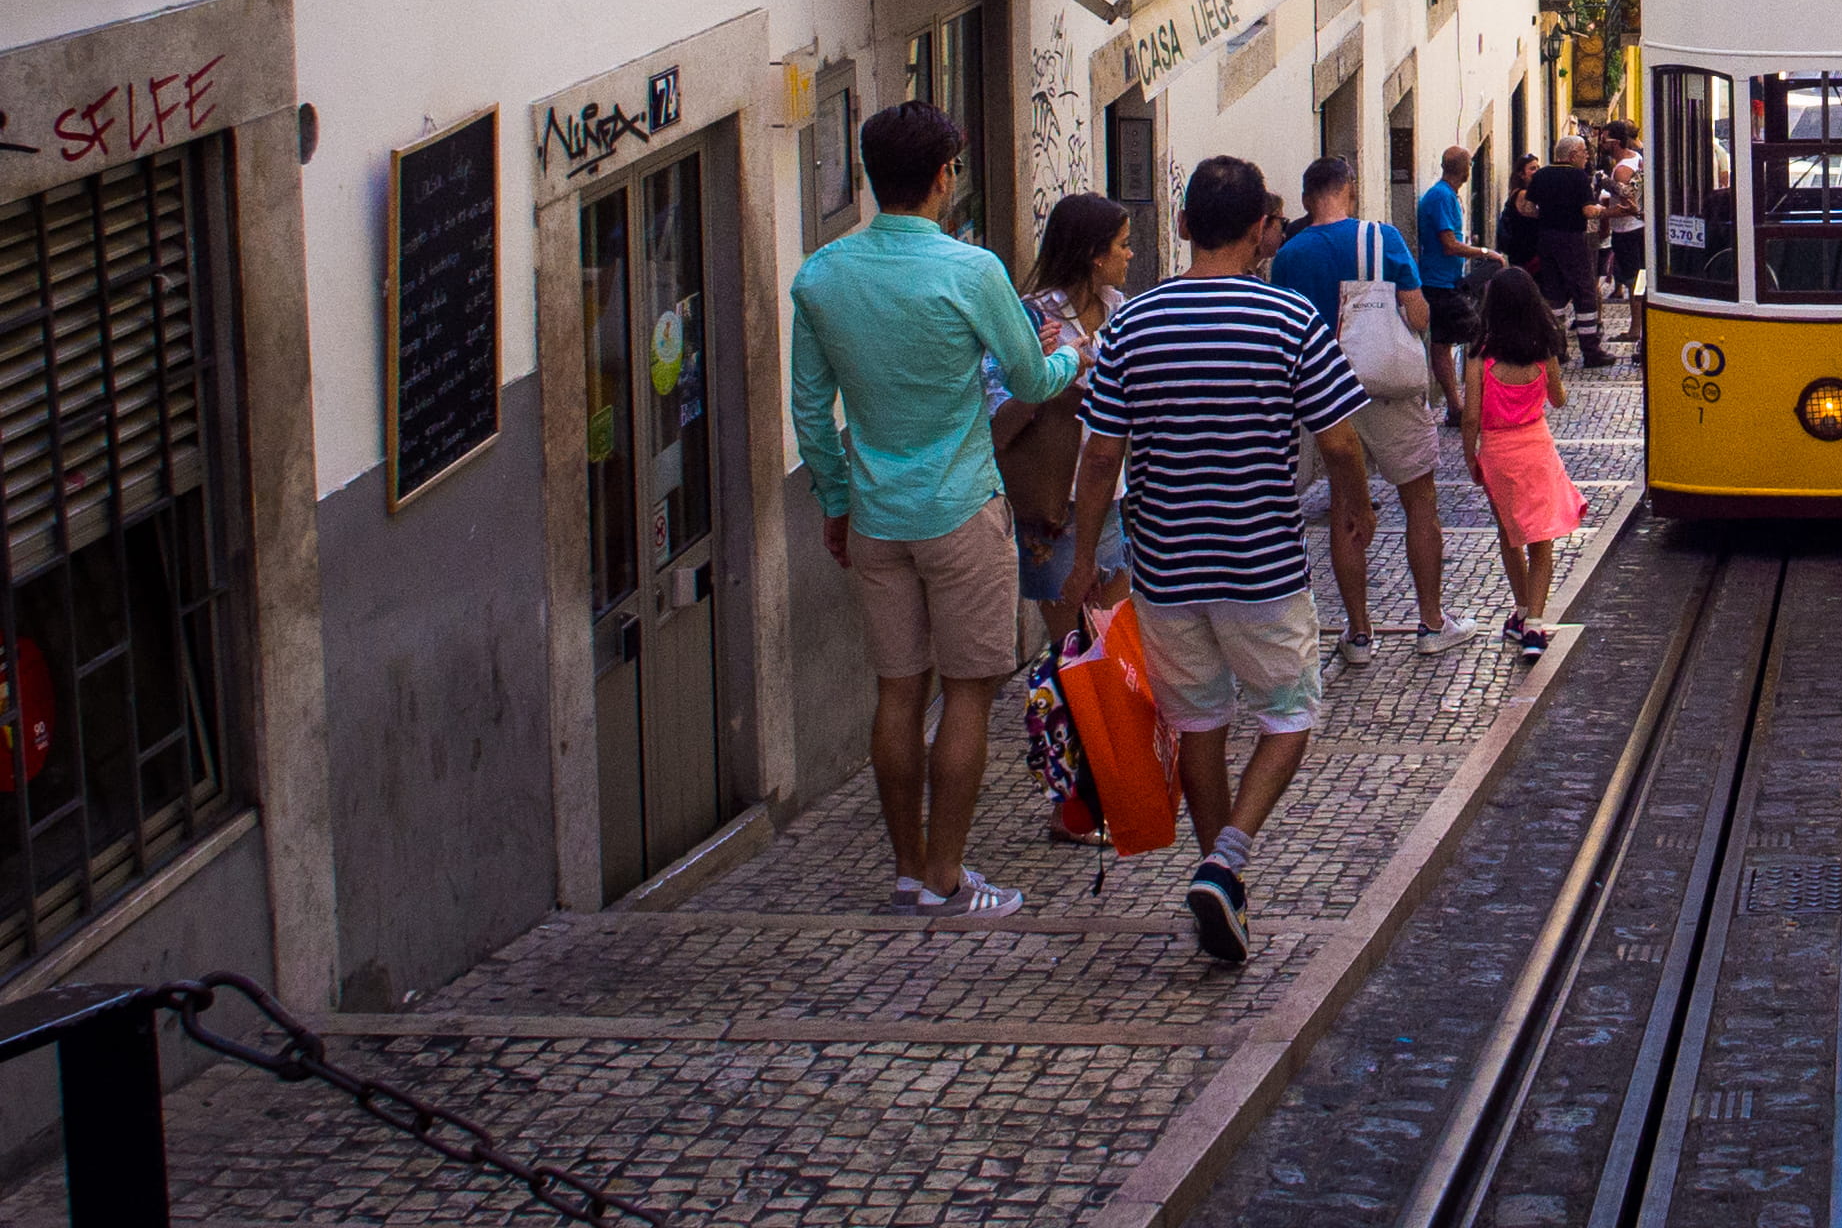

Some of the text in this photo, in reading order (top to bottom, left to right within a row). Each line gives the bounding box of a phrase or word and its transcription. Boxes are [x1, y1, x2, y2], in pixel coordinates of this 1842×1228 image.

[1137, 18, 1185, 87] CASA
[1670, 229, 1704, 242] 3.70 €
[1698, 406, 1704, 424] 1
